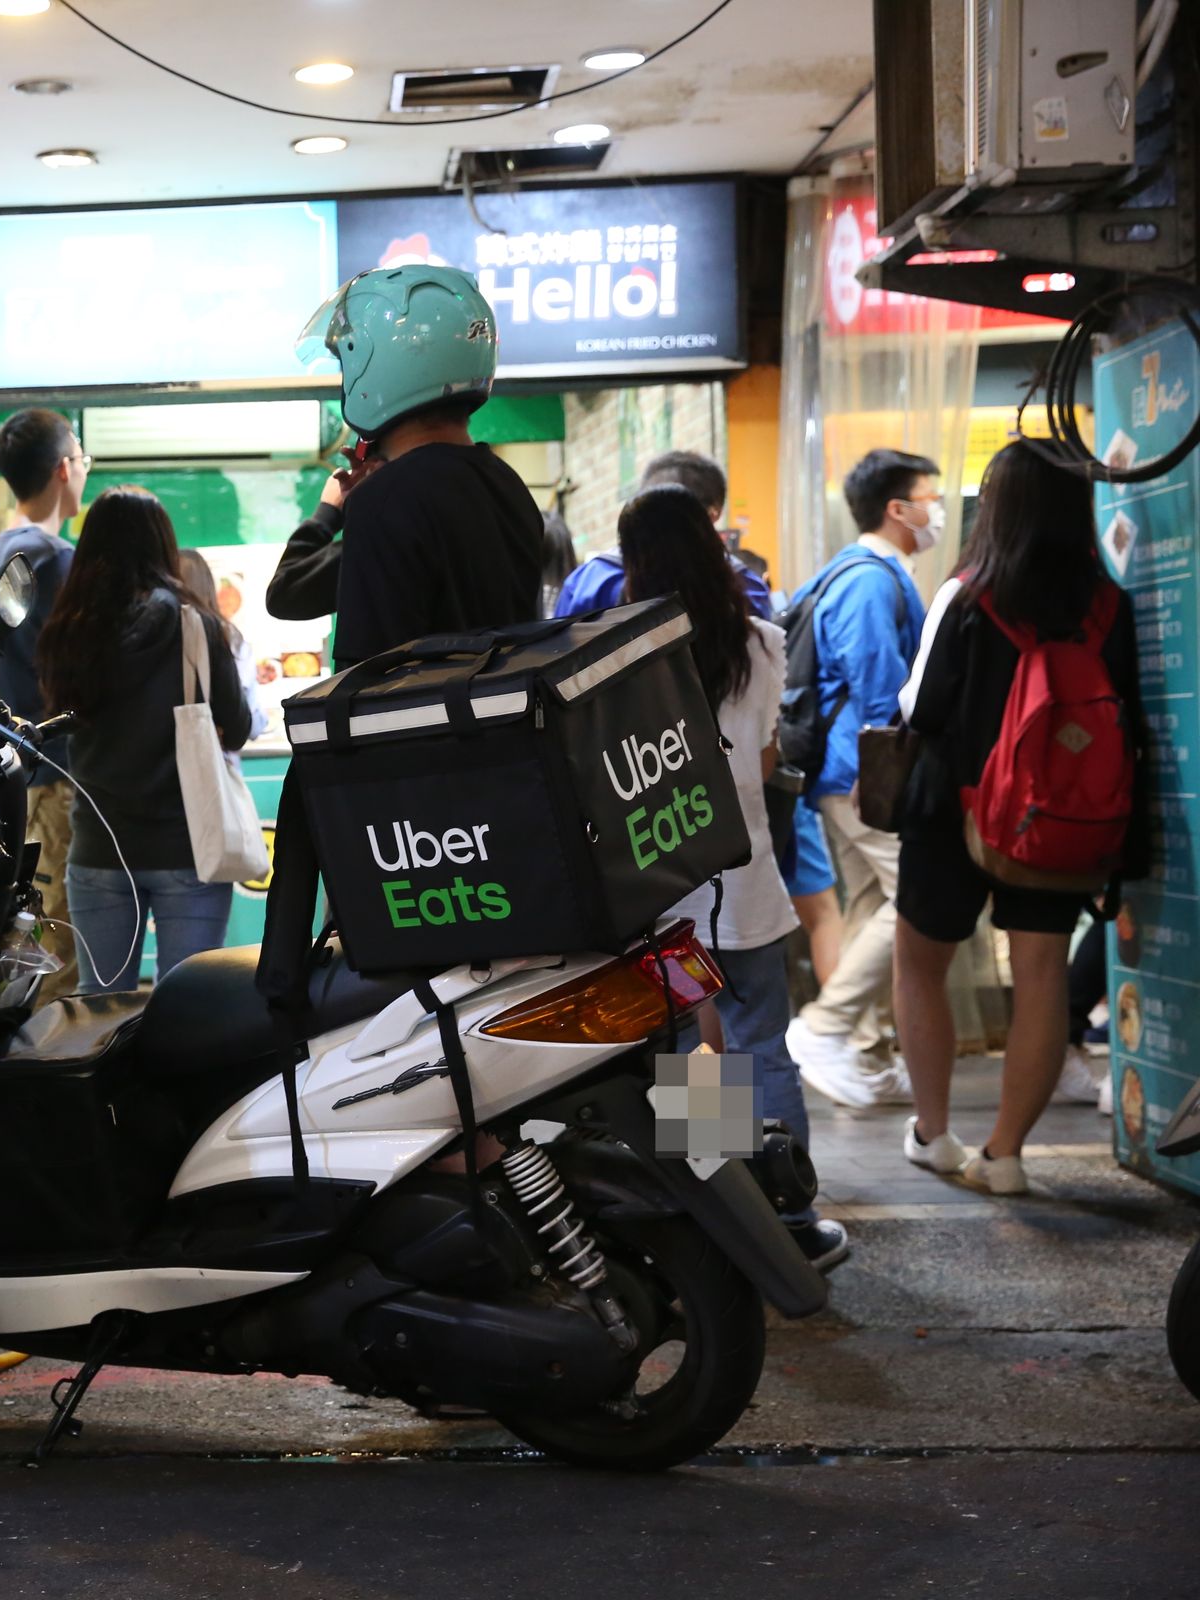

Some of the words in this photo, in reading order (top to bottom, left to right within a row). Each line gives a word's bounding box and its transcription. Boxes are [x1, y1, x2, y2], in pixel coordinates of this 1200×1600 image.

[478, 261, 677, 323] Hello!
[603, 718, 694, 801] Uber
[367, 820, 490, 872] Uber
[626, 783, 714, 871] Eats
[382, 876, 512, 928] Eats
